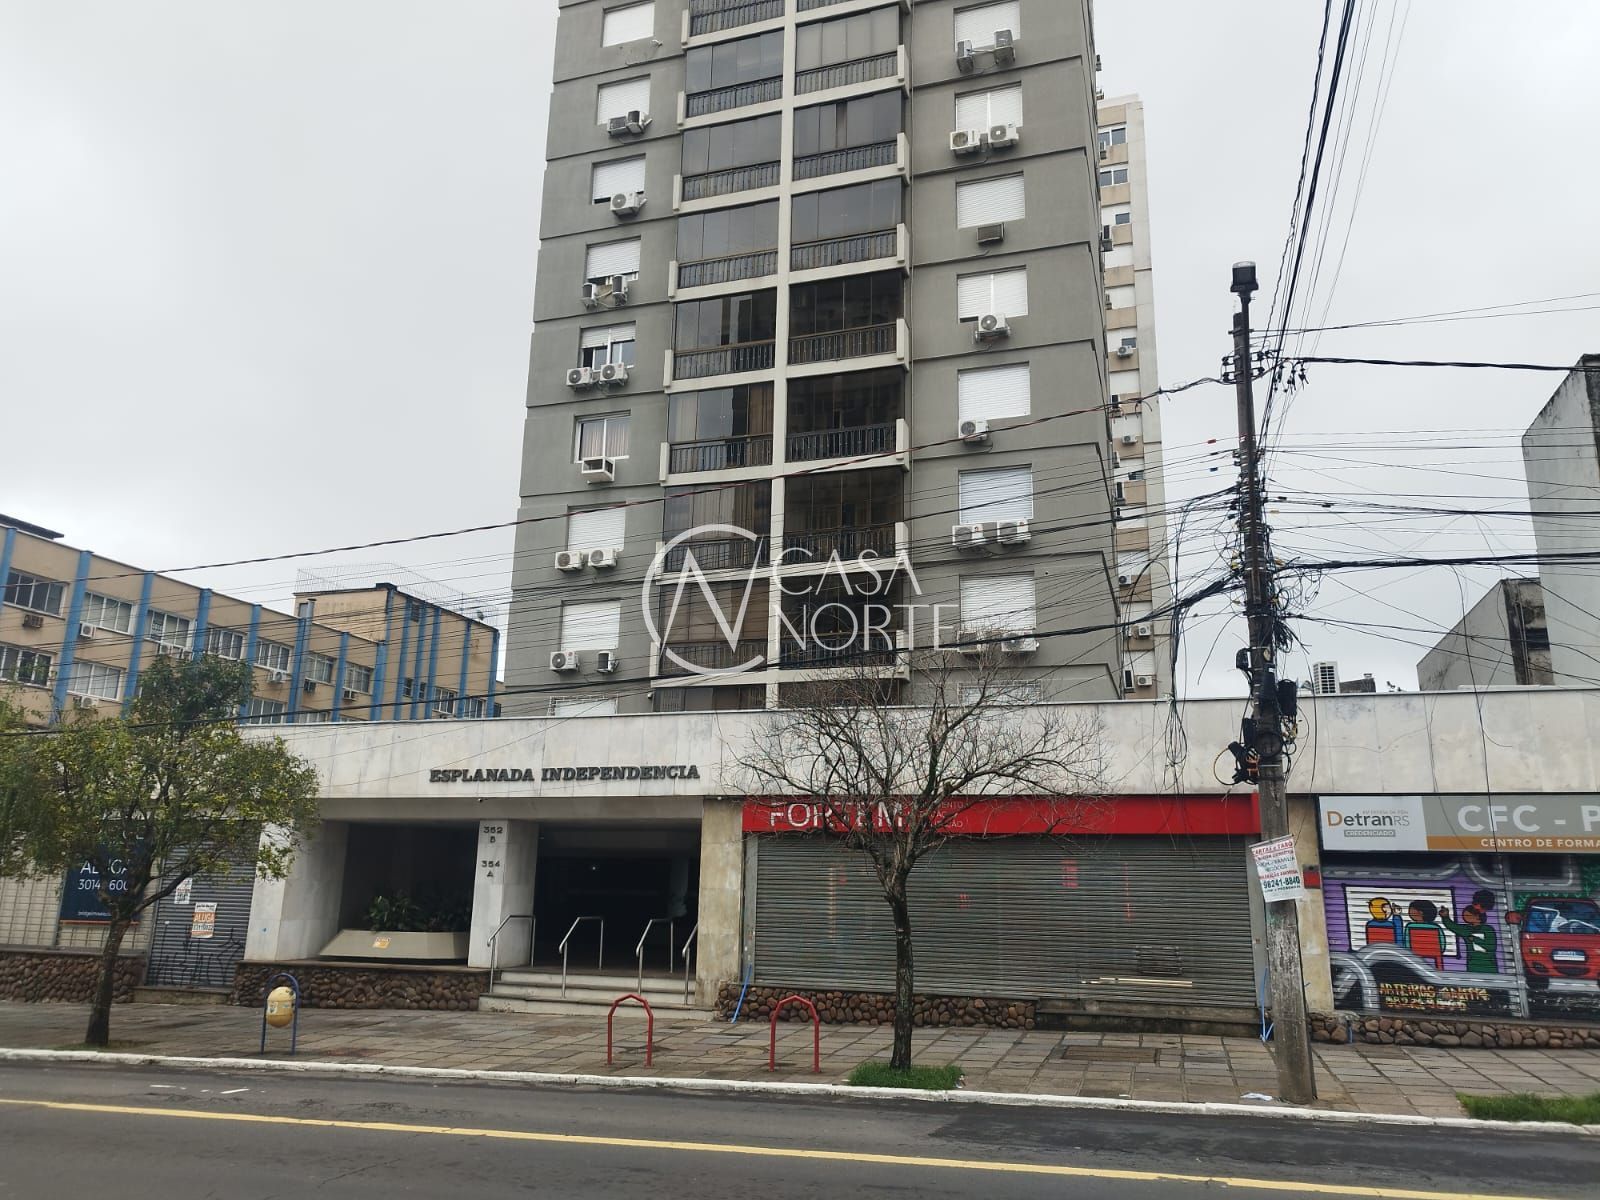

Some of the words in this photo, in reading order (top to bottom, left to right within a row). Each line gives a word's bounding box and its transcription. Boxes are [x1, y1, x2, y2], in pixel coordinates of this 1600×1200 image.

[429, 768, 535, 783] ESPLANADA
[541, 765, 701, 781] INDEPENDENCIA
[1327, 811, 1410, 827] DetranRS
[1457, 805, 1541, 833] CFC
[483, 826, 503, 834] 352
[1480, 838, 1535, 848] CENTRO
[1536, 838, 1553, 848] DE
[481, 860, 500, 868] 354
